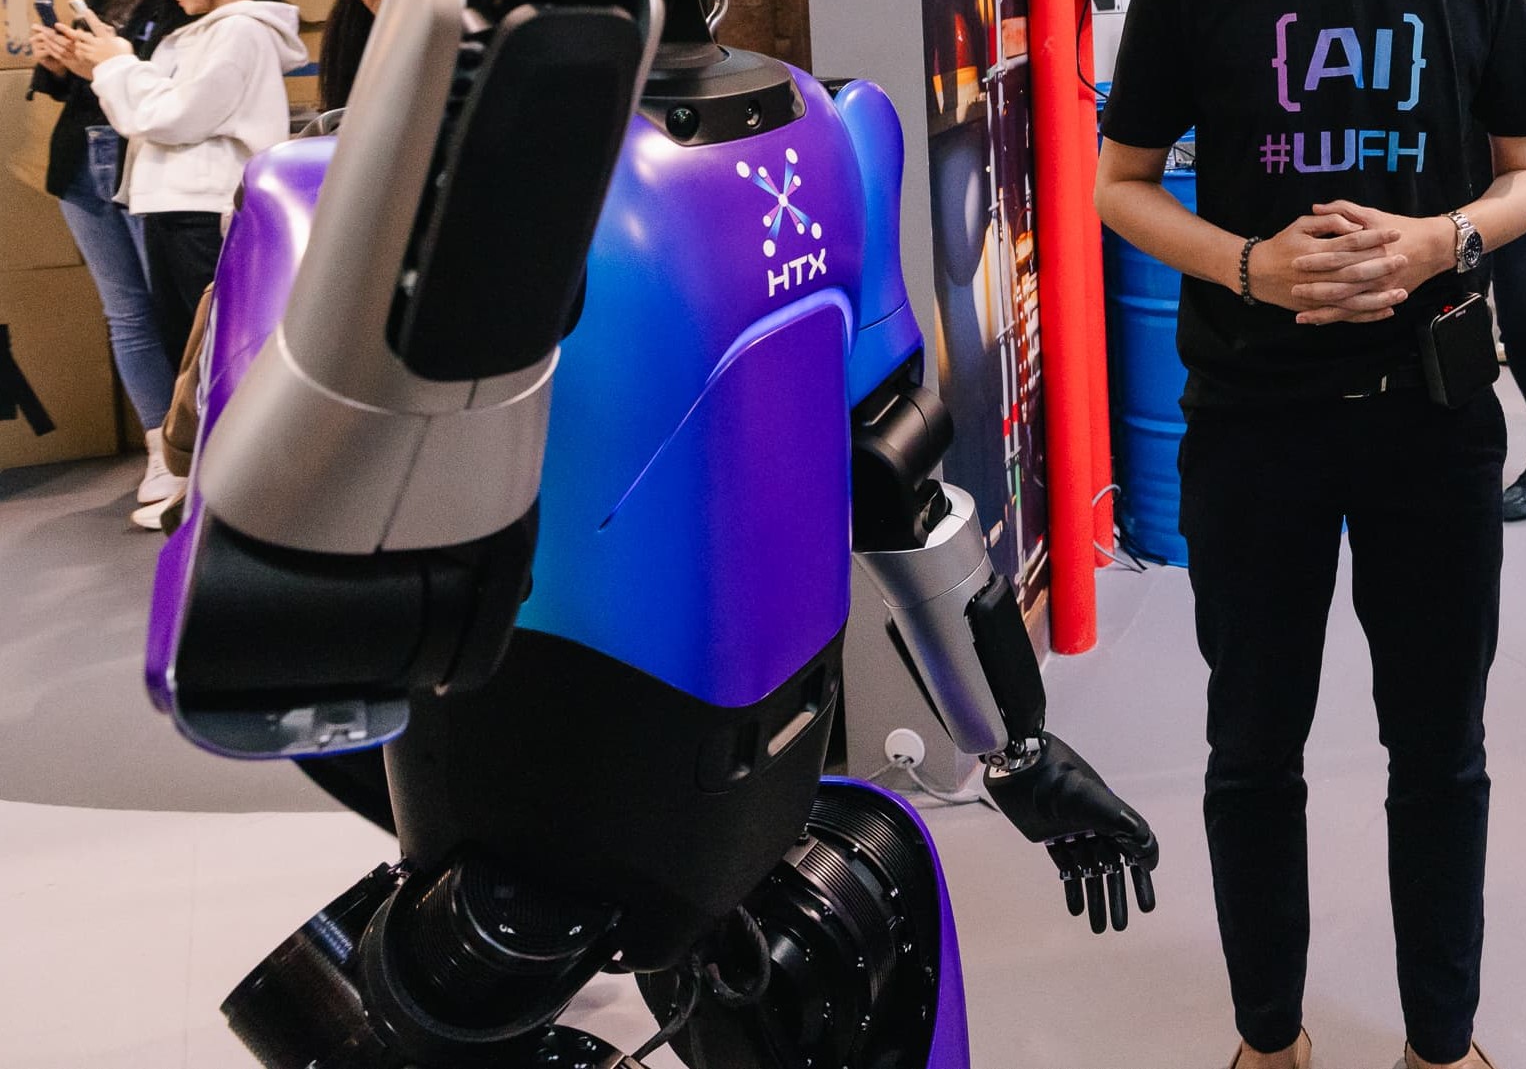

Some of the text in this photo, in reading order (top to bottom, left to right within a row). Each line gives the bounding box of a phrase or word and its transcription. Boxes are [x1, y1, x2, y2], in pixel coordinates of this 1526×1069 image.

[1271, 12, 1427, 112] {AI}
[1259, 128, 1427, 173] #WFH
[767, 247, 827, 298] HTX
